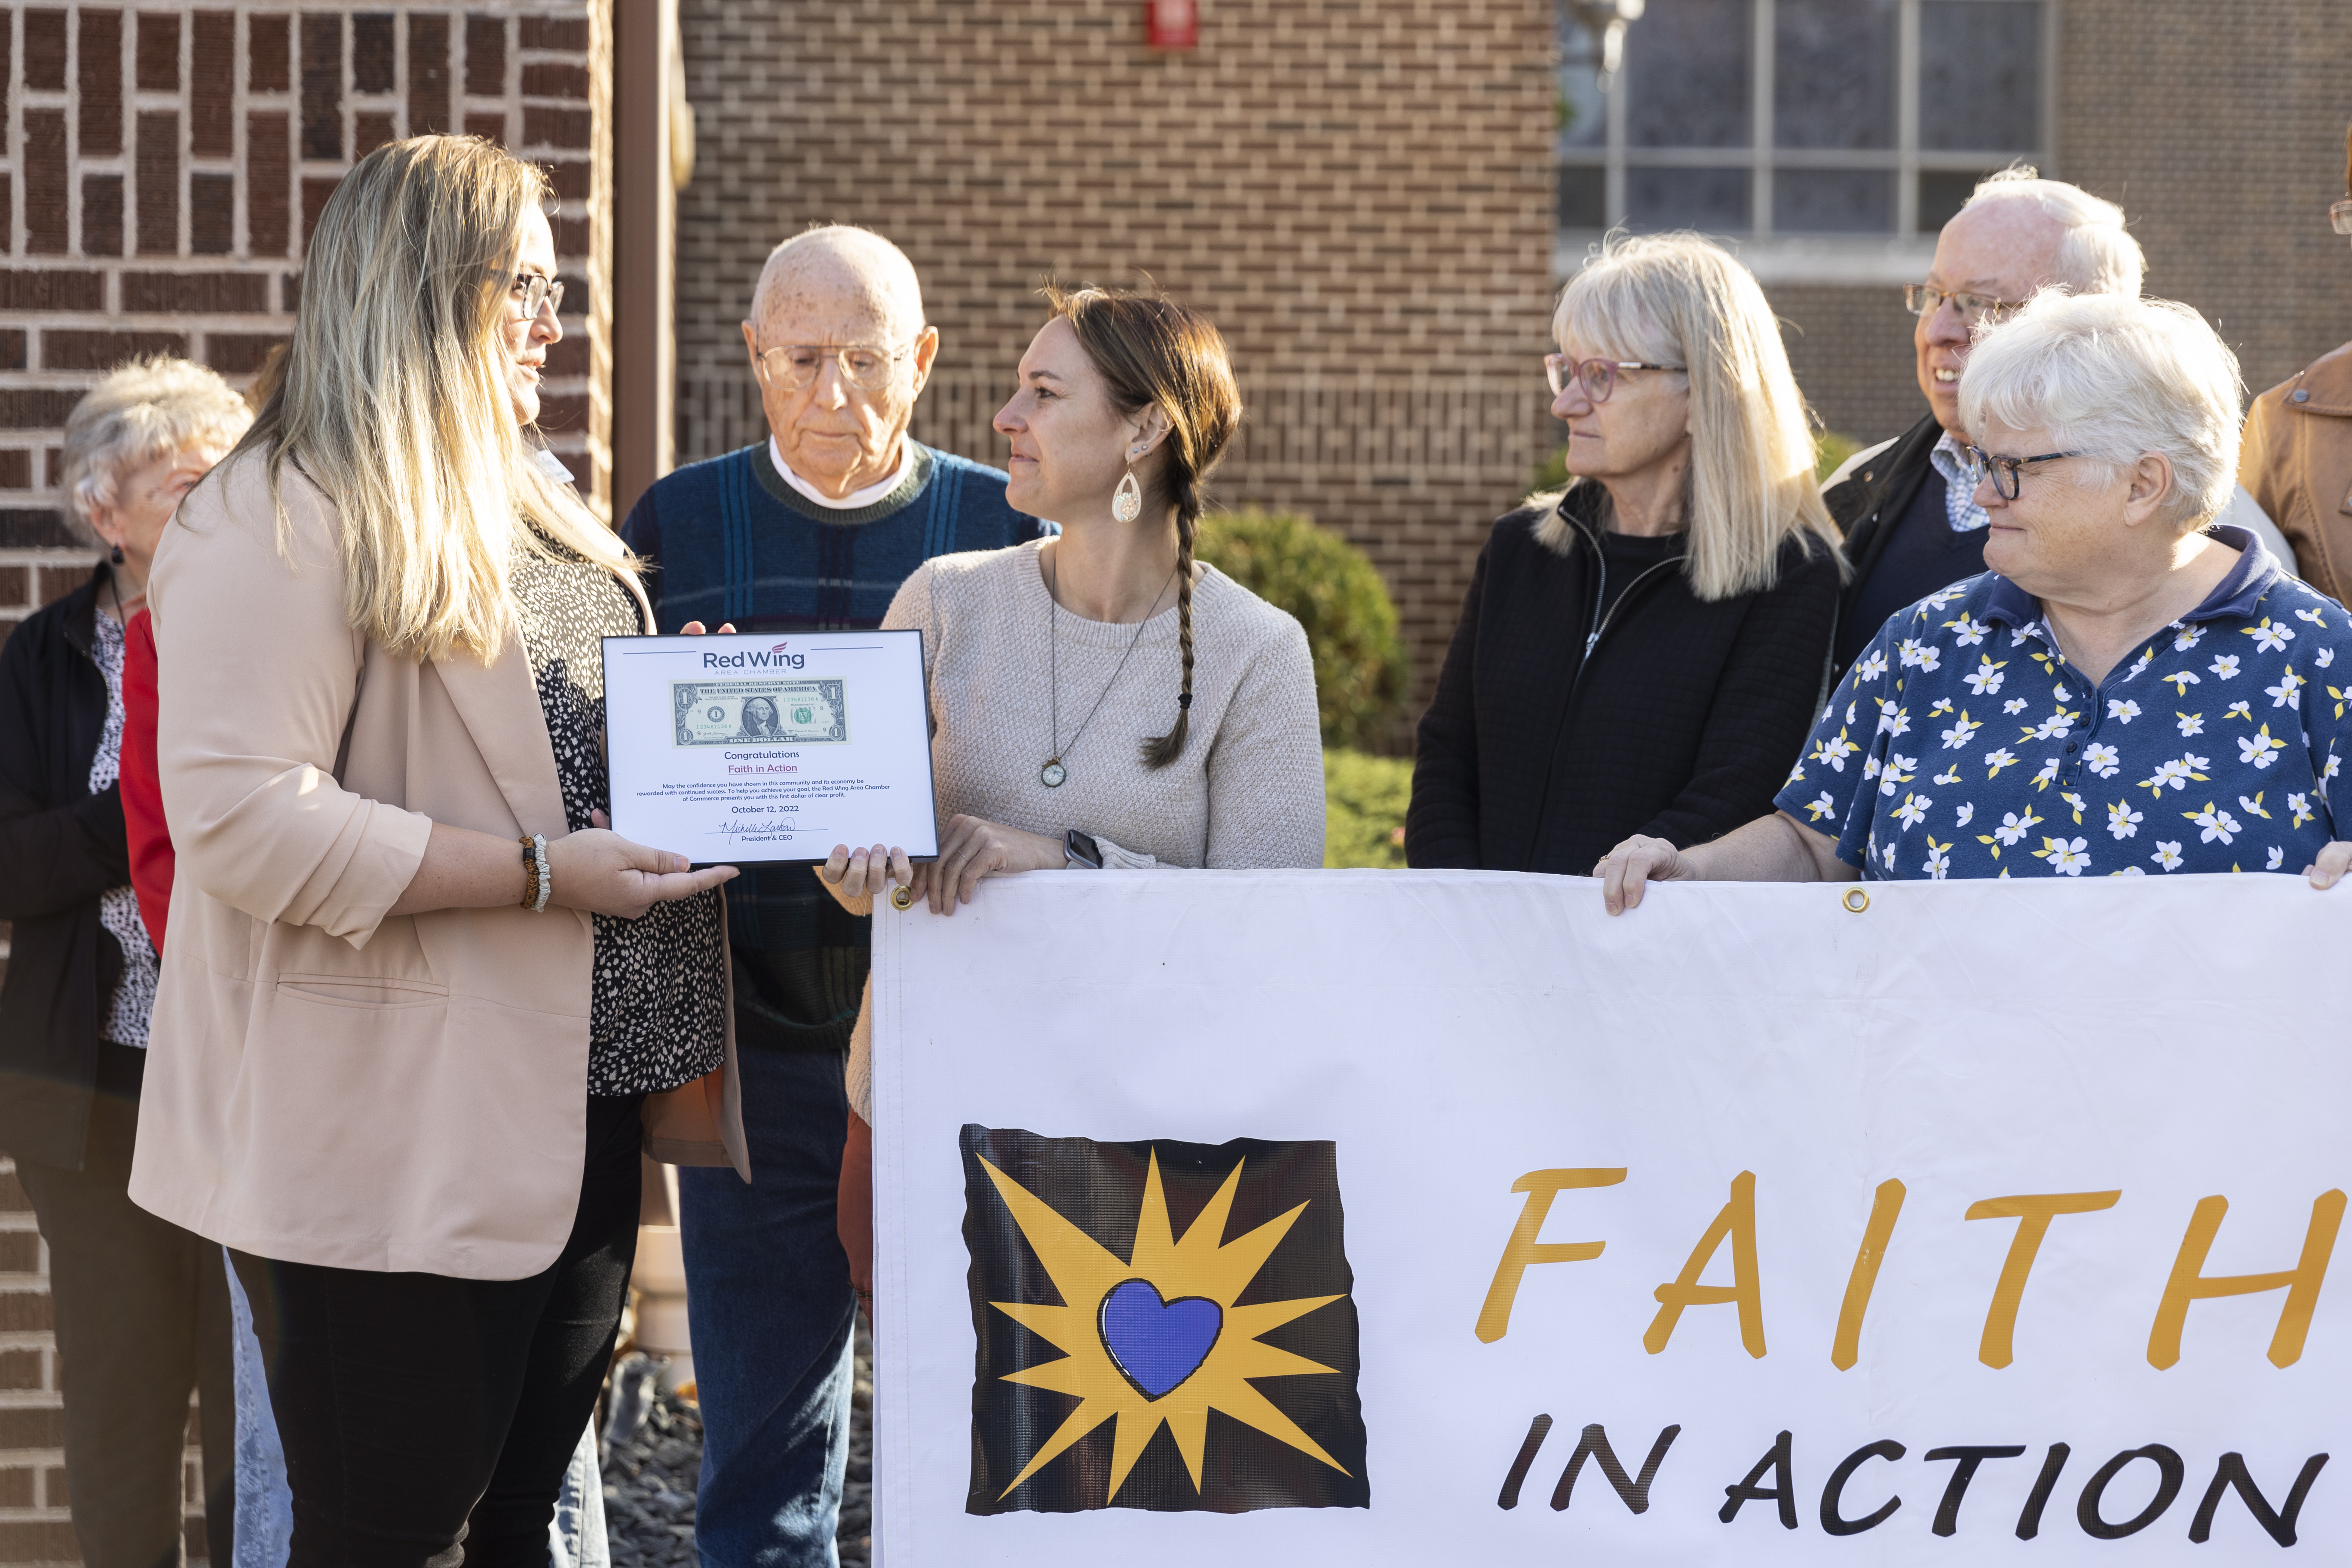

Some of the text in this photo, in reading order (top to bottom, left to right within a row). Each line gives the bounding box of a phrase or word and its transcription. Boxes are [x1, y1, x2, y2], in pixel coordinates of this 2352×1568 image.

[703, 651, 805, 669] Red Wing
[683, 692, 688, 704] 1
[830, 687, 836, 699] 1
[683, 732, 688, 740] 1
[724, 750, 799, 760] Congratulations
[728, 765, 753, 773] Faith
[767, 764, 797, 772] Action
[1474, 1167, 2349, 1372] FAITH
[1497, 1413, 2330, 1548] IN ACTION
